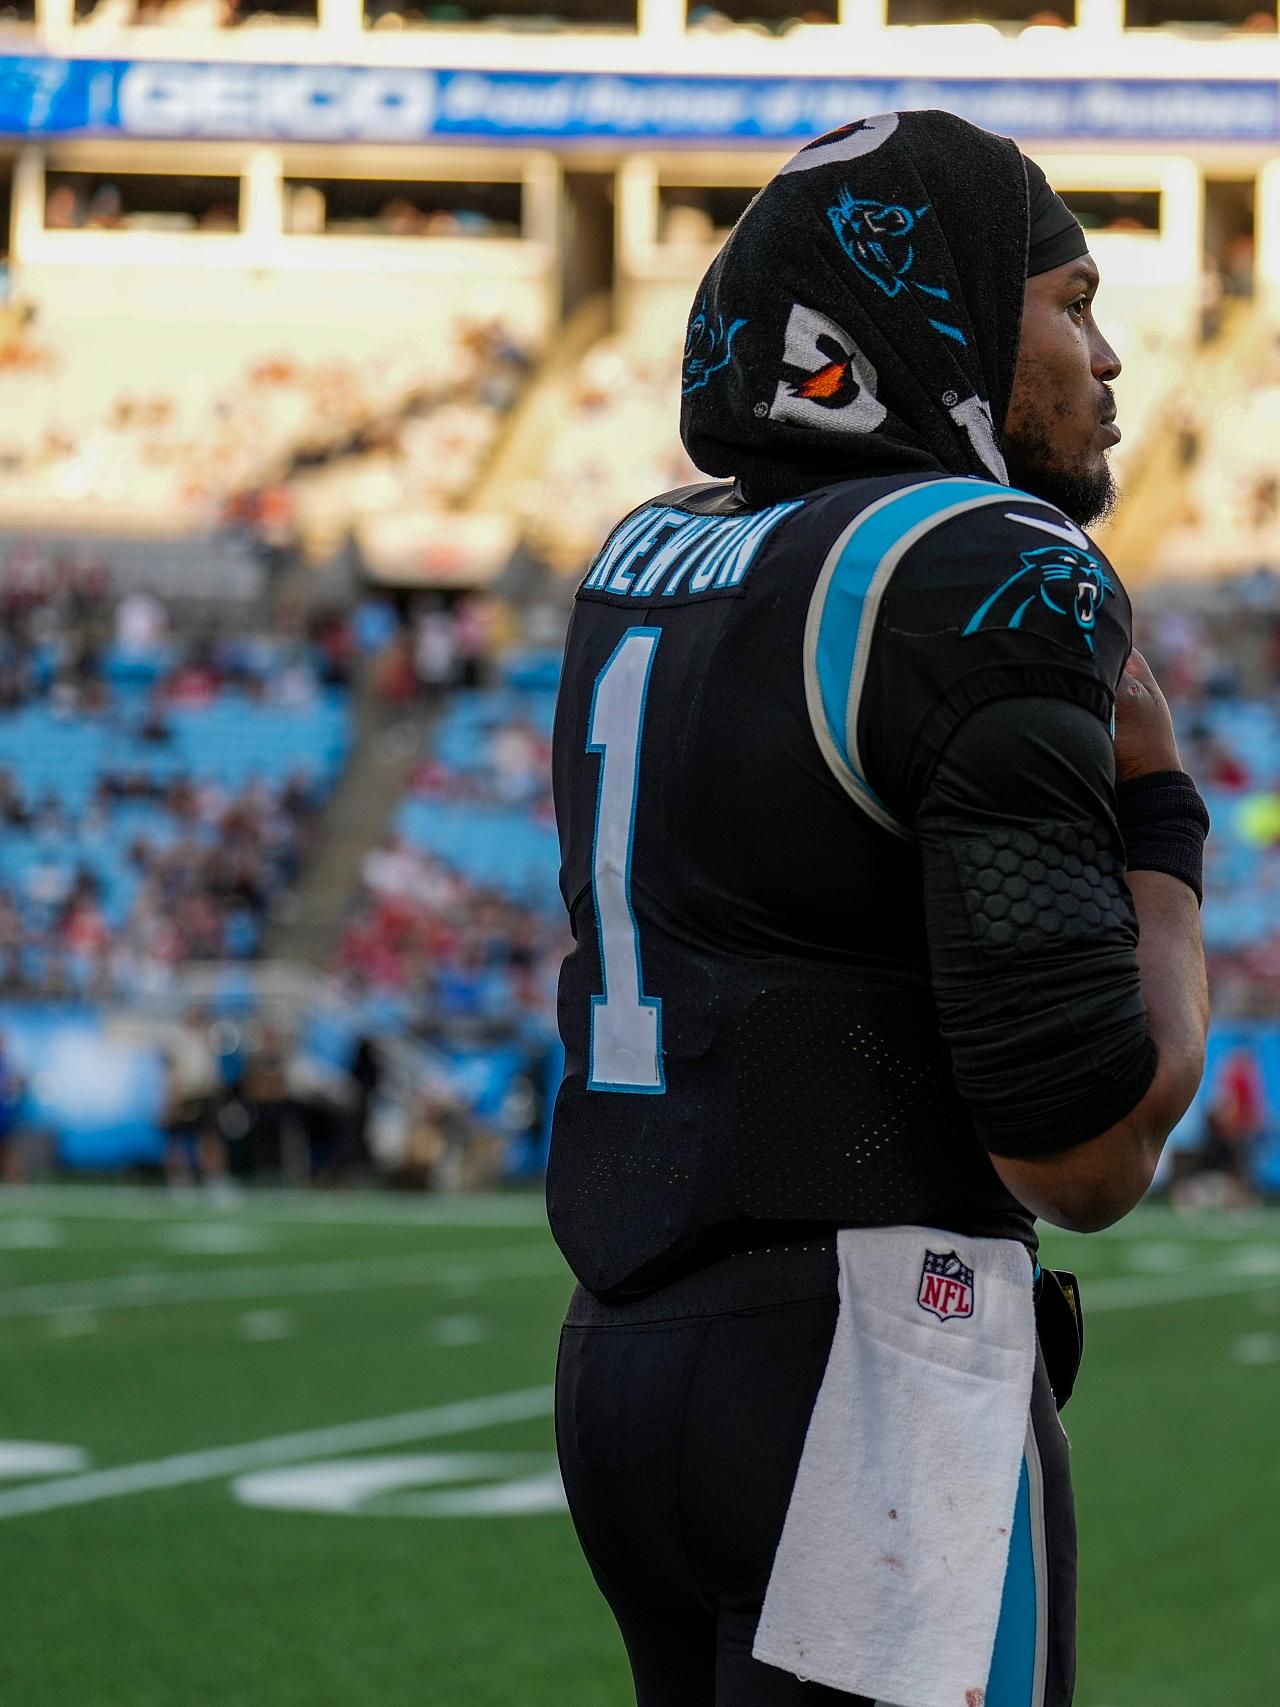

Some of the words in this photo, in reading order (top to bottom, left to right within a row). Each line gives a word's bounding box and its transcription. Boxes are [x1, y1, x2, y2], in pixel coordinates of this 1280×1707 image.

[118, 64, 434, 137] GEICO
[583, 500, 804, 596] NEWTON
[586, 627, 666, 1094] 1
[921, 1275, 969, 1314] NFL
